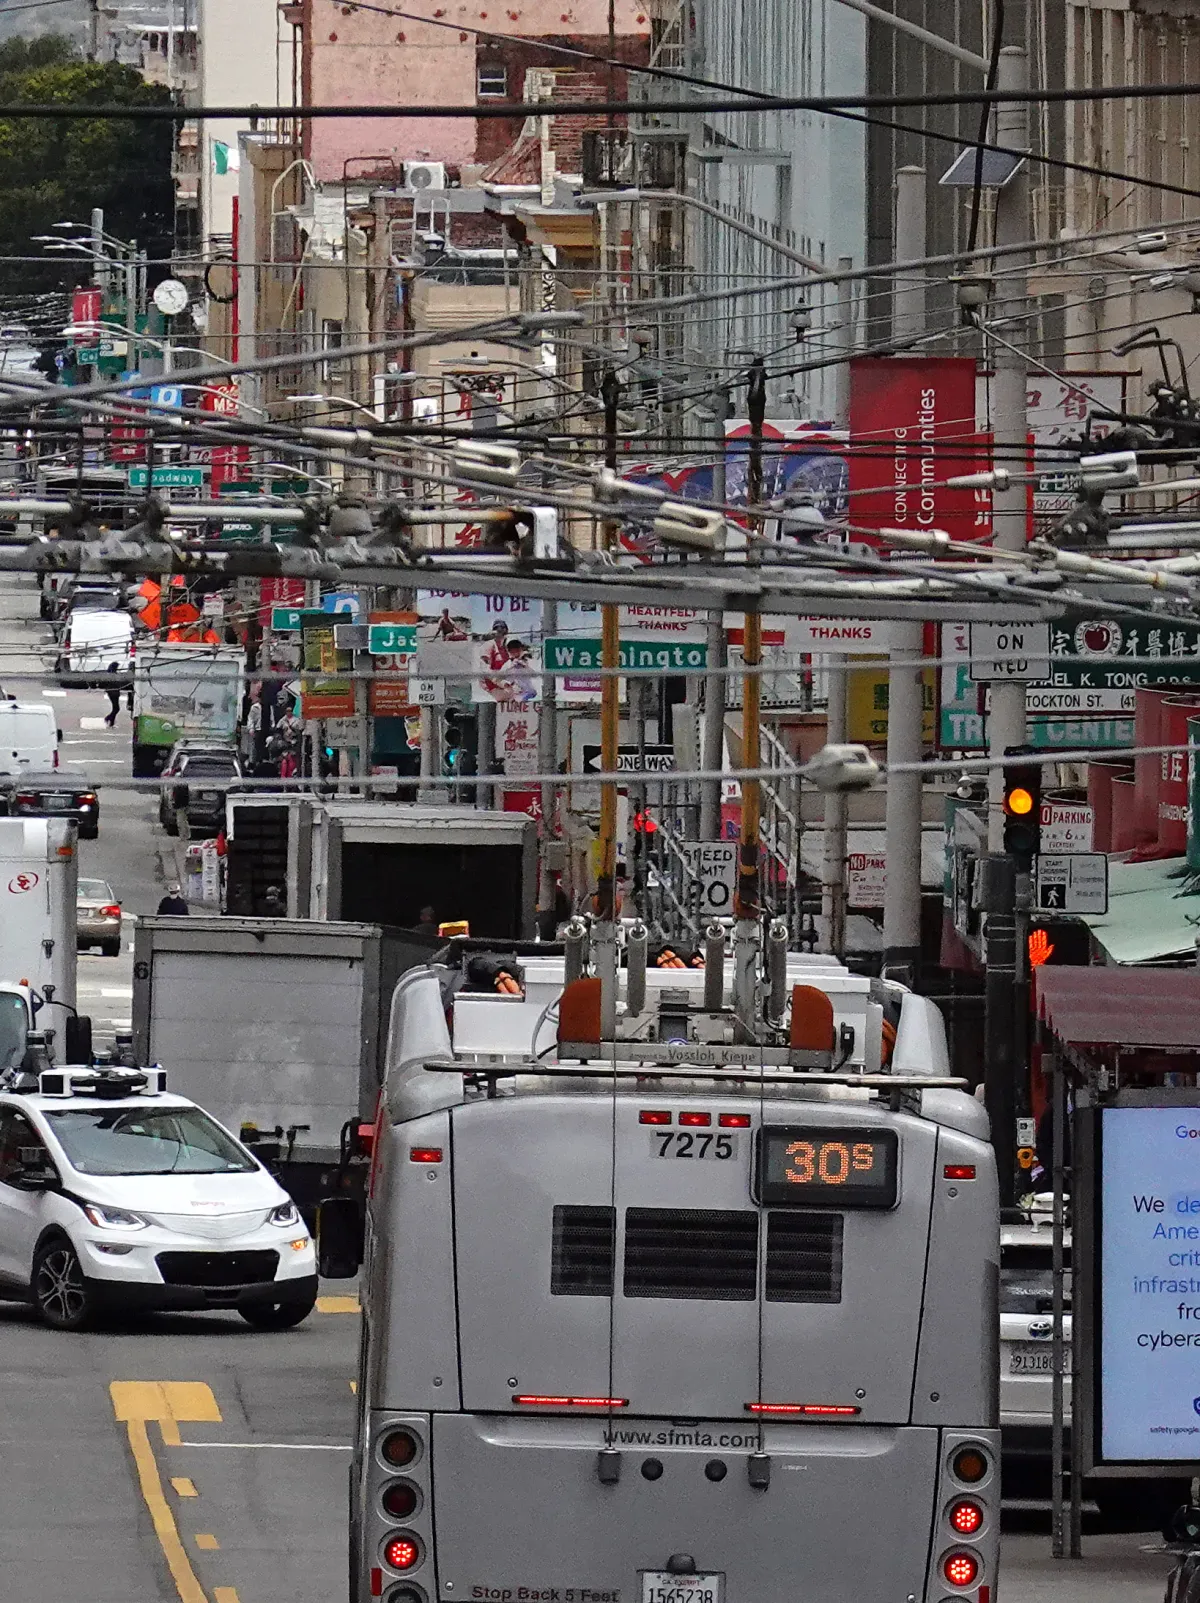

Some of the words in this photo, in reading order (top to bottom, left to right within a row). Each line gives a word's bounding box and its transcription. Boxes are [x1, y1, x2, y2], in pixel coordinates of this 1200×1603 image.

[485, 596, 504, 612] TO
[510, 596, 530, 612] BE
[628, 605, 697, 617] HEARTFELT
[638, 620, 687, 631] THANKS
[809, 627, 872, 639] THANKS
[997, 634, 1024, 650] ON
[555, 647, 709, 668] Wasingto
[1080, 673, 1096, 687] K.
[1105, 673, 1148, 686] TONG
[1027, 695, 1080, 708] TOCKTON
[1086, 695, 1104, 708] ST.
[1046, 721, 1131, 743] CENTE
[1053, 811, 1092, 824] PARKING
[851, 855, 864, 870] NO
[133, 961, 149, 980] 6
[668, 1050, 714, 1061] Vossloh
[722, 1050, 757, 1064] Kiepe
[656, 1132, 733, 1160] 7275
[1133, 1196, 1165, 1213] We
[603, 1429, 763, 1448] www.sfmta.com
[471, 1586, 512, 1602] Stop
[518, 1586, 559, 1601] Back
[565, 1588, 574, 1601] 5
[580, 1588, 619, 1602] Feet
